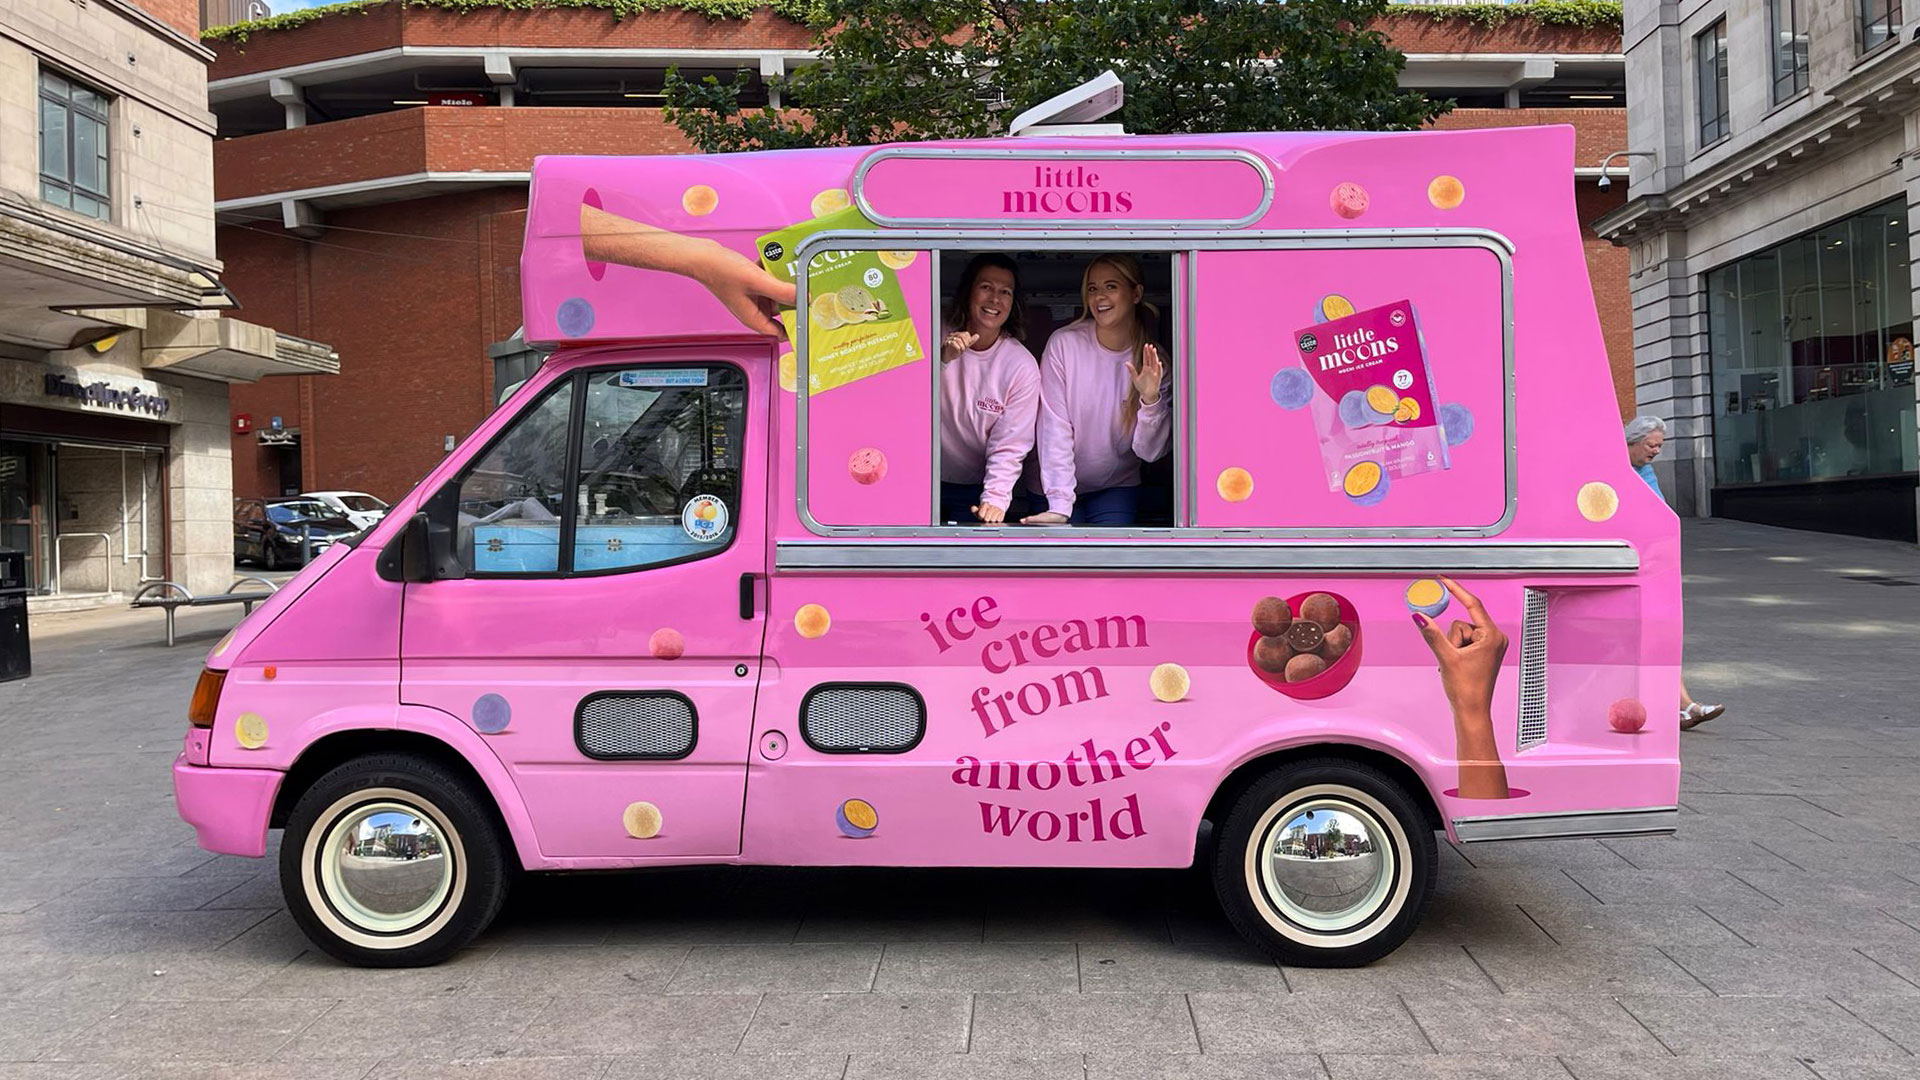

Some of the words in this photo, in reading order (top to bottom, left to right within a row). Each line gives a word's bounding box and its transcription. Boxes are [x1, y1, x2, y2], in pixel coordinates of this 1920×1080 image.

[1035, 166, 1100, 188] little
[1002, 191, 1133, 213] moons
[1334, 328, 1376, 350] little
[1319, 337, 1399, 371] moons
[1365, 359, 1383, 367] CREAM
[1397, 374, 1408, 383] 77
[1391, 439, 1415, 450] MANGO
[1427, 450, 1434, 460] 6
[693, 495, 719, 504] MEMBER
[920, 595, 1002, 654] ice
[981, 614, 1149, 674] cream
[971, 666, 1110, 739] from
[951, 721, 1178, 791] another
[977, 793, 1148, 843] world
